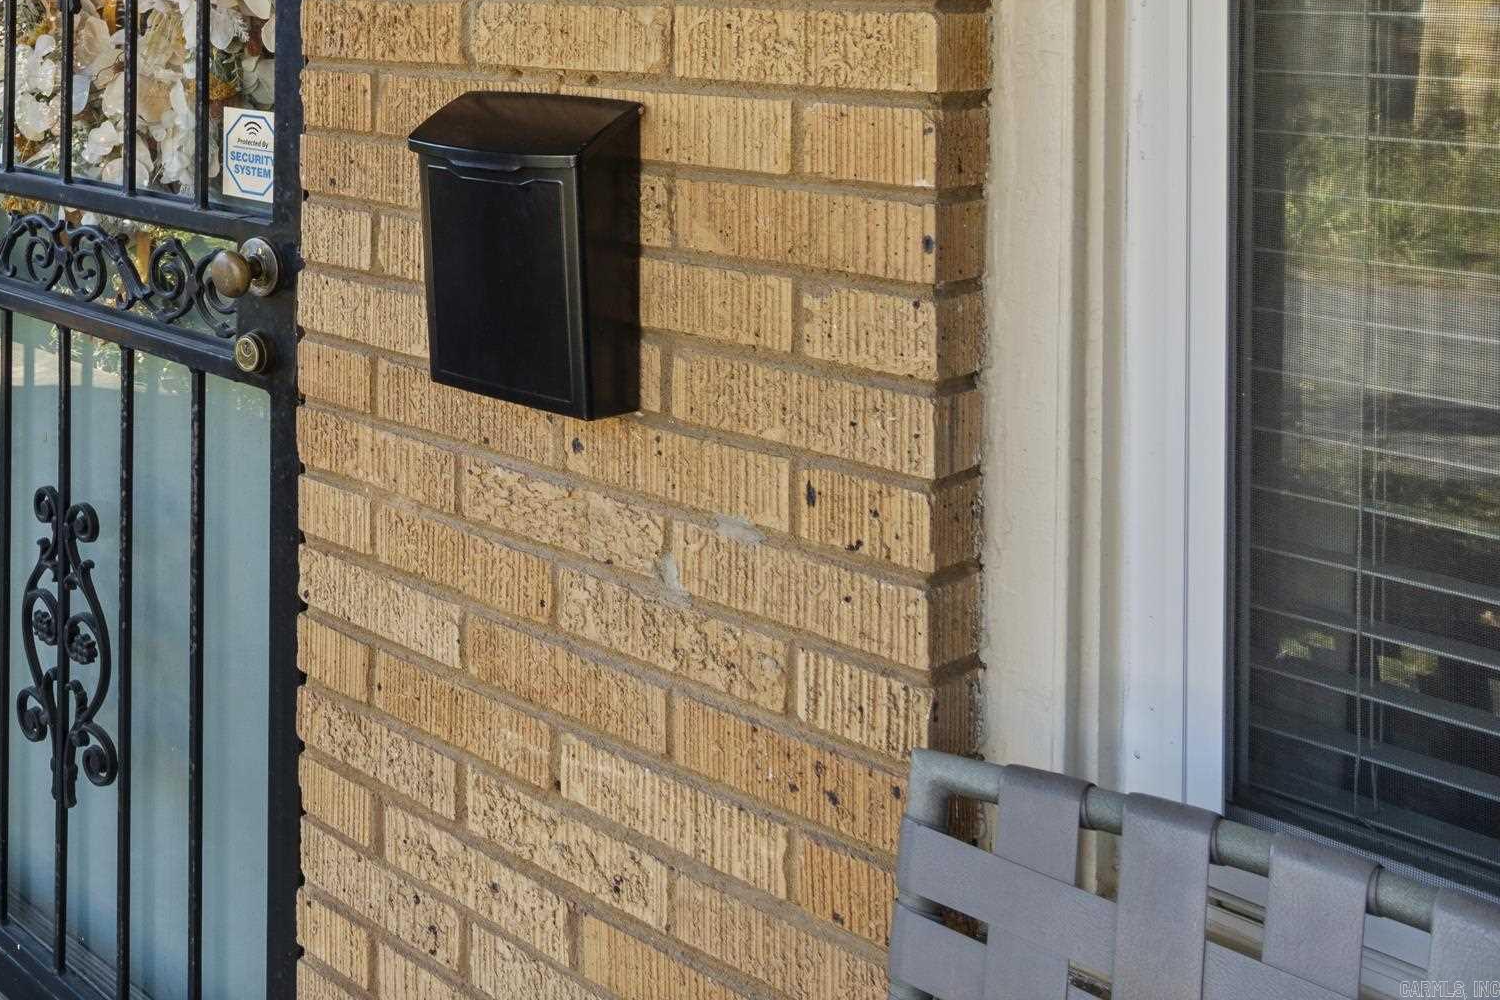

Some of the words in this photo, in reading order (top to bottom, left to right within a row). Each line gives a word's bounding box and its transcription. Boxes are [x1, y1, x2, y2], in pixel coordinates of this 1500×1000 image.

[237, 138, 261, 147] Protected
[262, 141, 269, 149] By
[230, 151, 274, 165] SECURITY
[234, 164, 271, 179] SYSTEM
